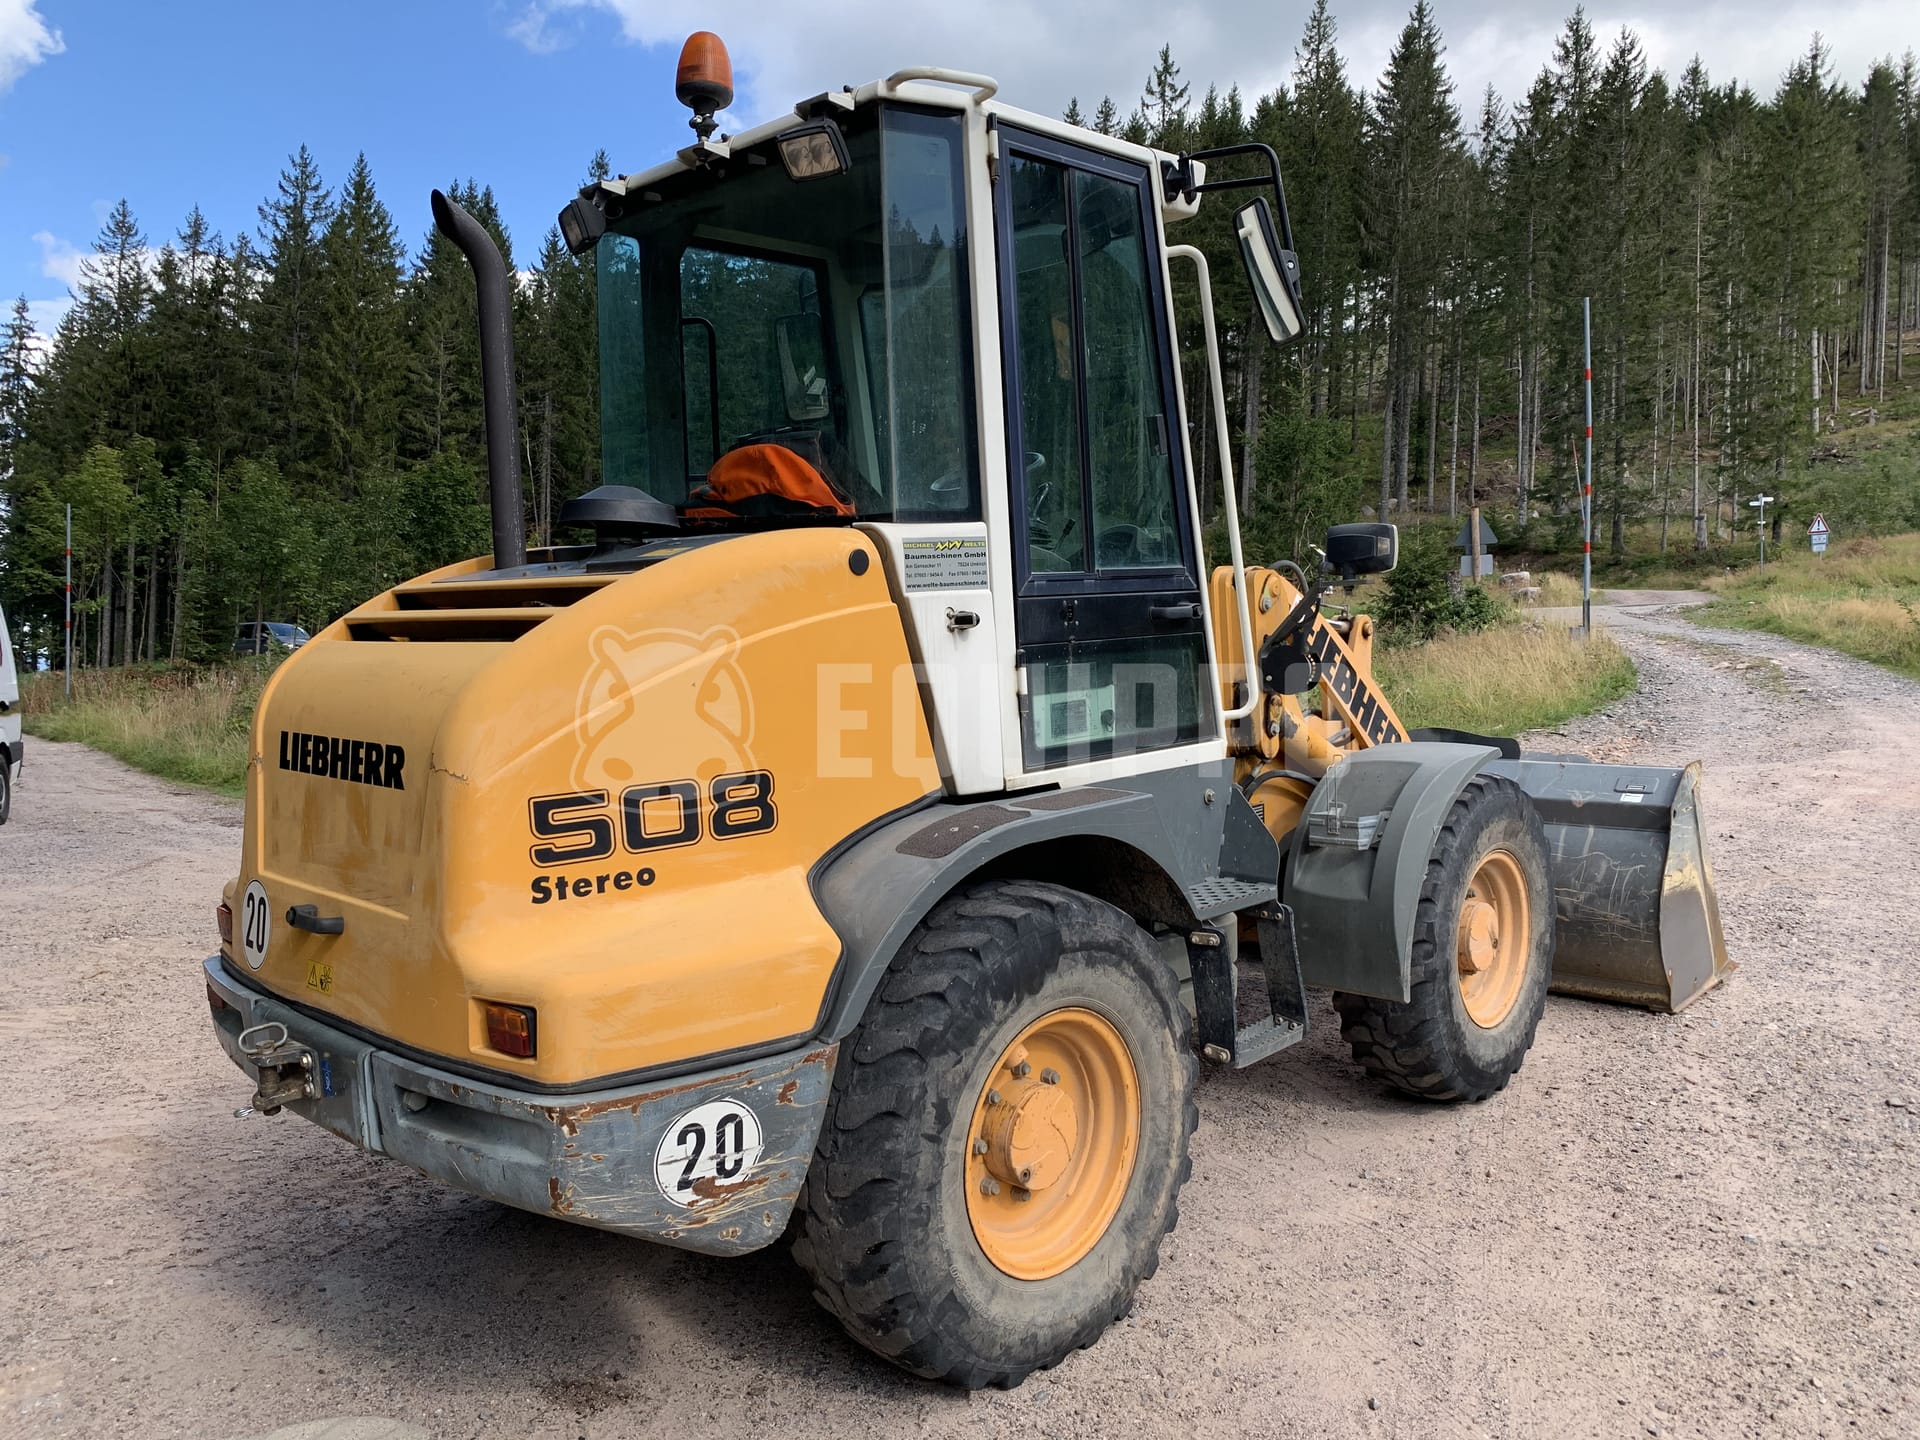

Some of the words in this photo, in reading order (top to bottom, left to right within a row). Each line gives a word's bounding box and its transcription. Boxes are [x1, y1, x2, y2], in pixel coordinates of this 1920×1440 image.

[904, 552, 962, 560] Baumaschinen
[279, 731, 405, 790] LIEBHERR
[528, 769, 778, 869] 508
[531, 867, 656, 904] Stereo
[246, 892, 266, 953] 20
[677, 1113, 743, 1191] 20
